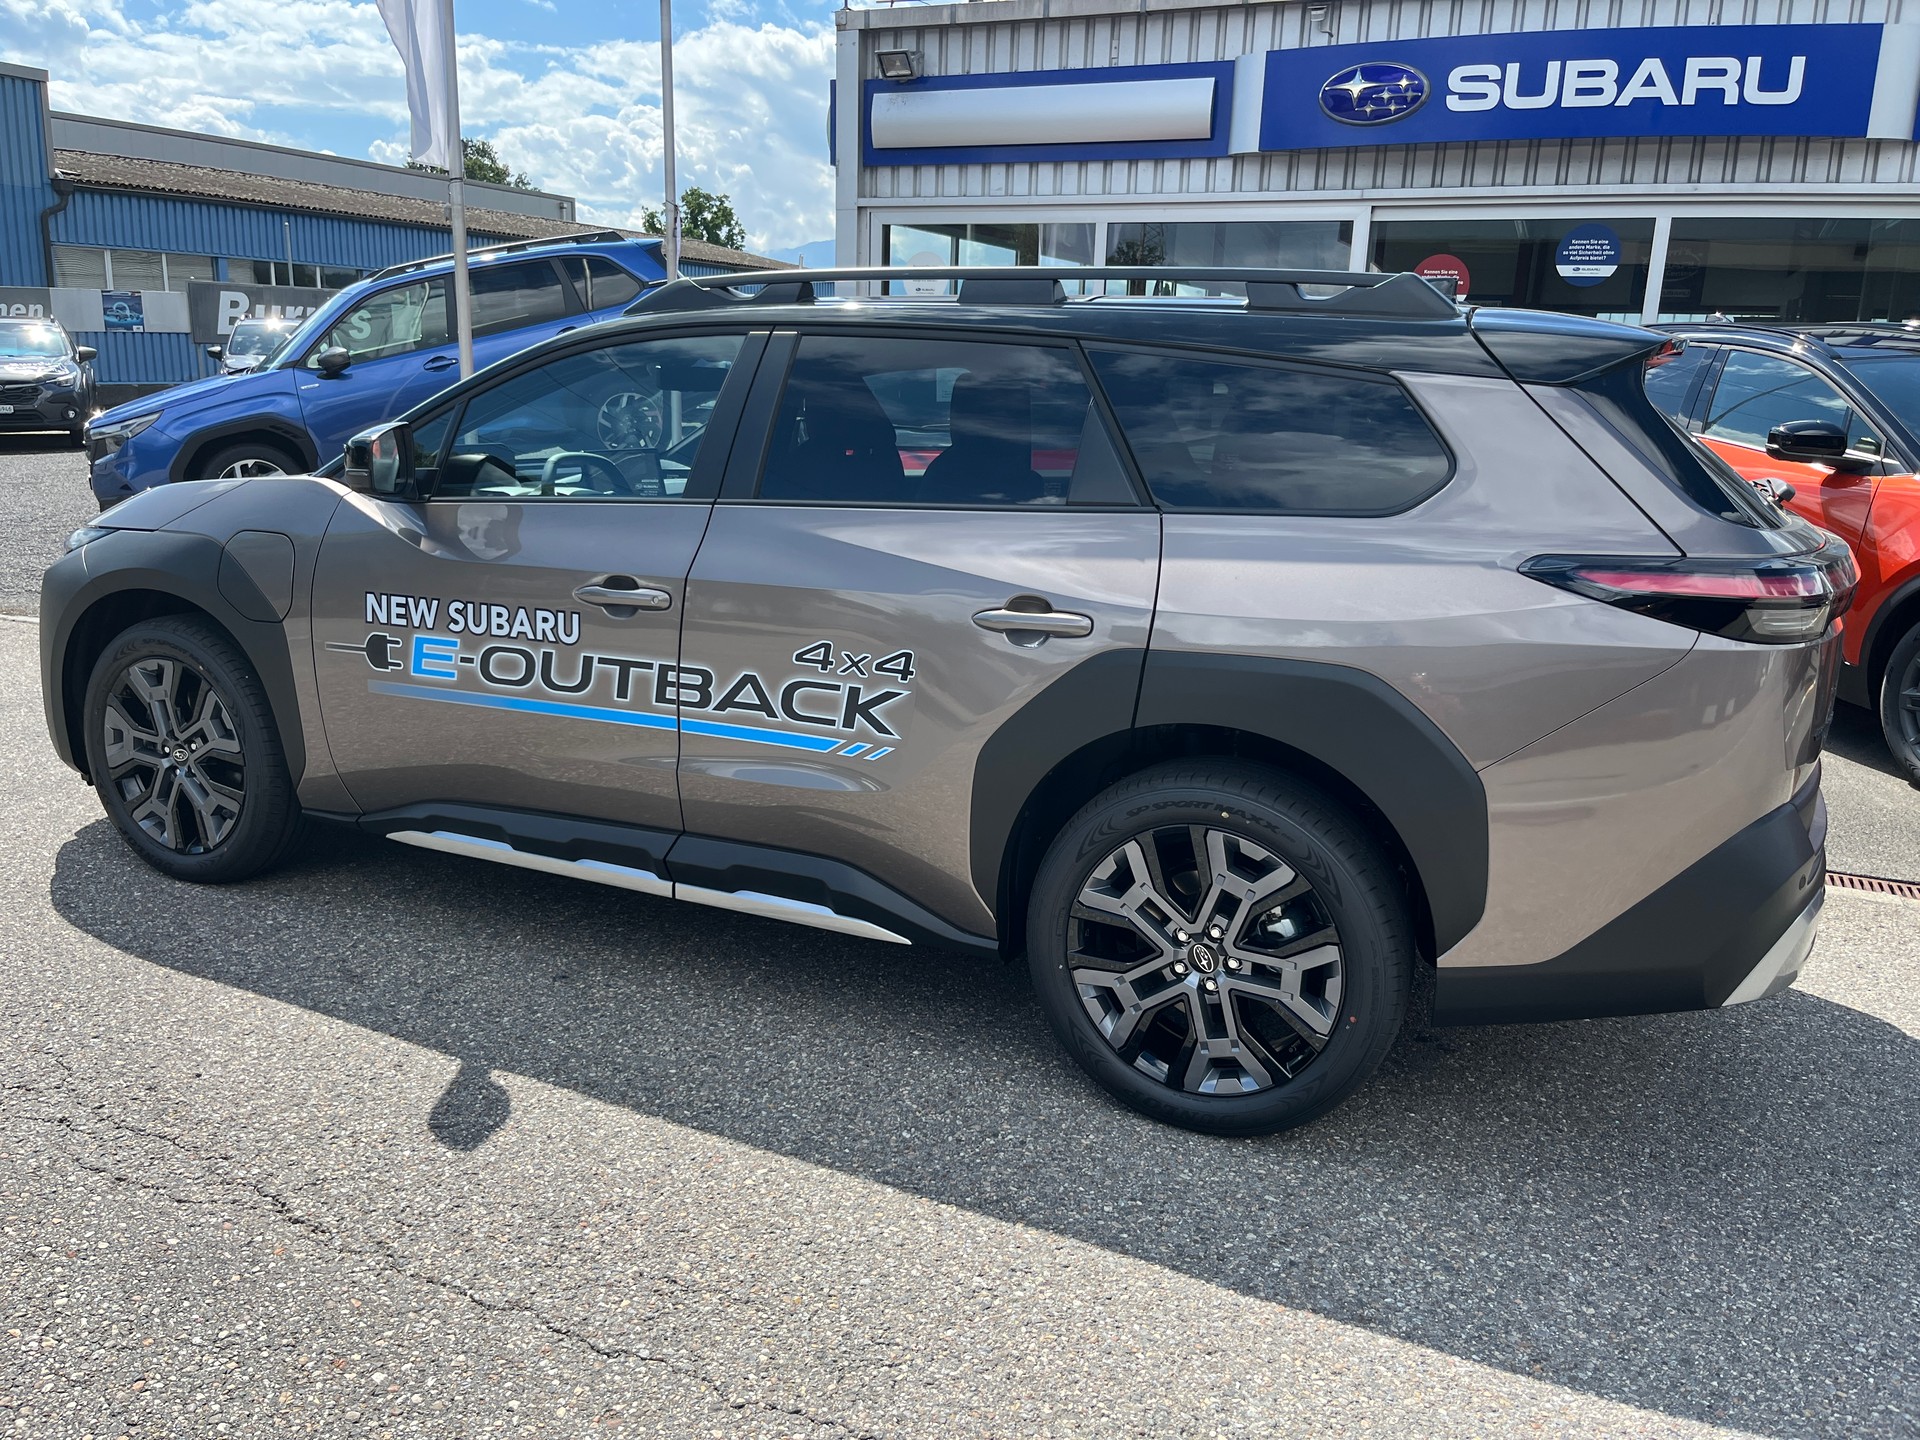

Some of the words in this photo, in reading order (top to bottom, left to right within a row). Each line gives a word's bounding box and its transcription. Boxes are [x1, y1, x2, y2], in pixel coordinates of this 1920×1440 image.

[1446, 56, 1806, 112] SUBARU
[365, 592, 440, 629] NEW
[448, 600, 581, 645] SUBARU
[411, 635, 911, 739] E-OUTBACK
[793, 640, 915, 683] 4x4
[1151, 800, 1214, 811] SPORT
[1213, 804, 1281, 834] MAXX
